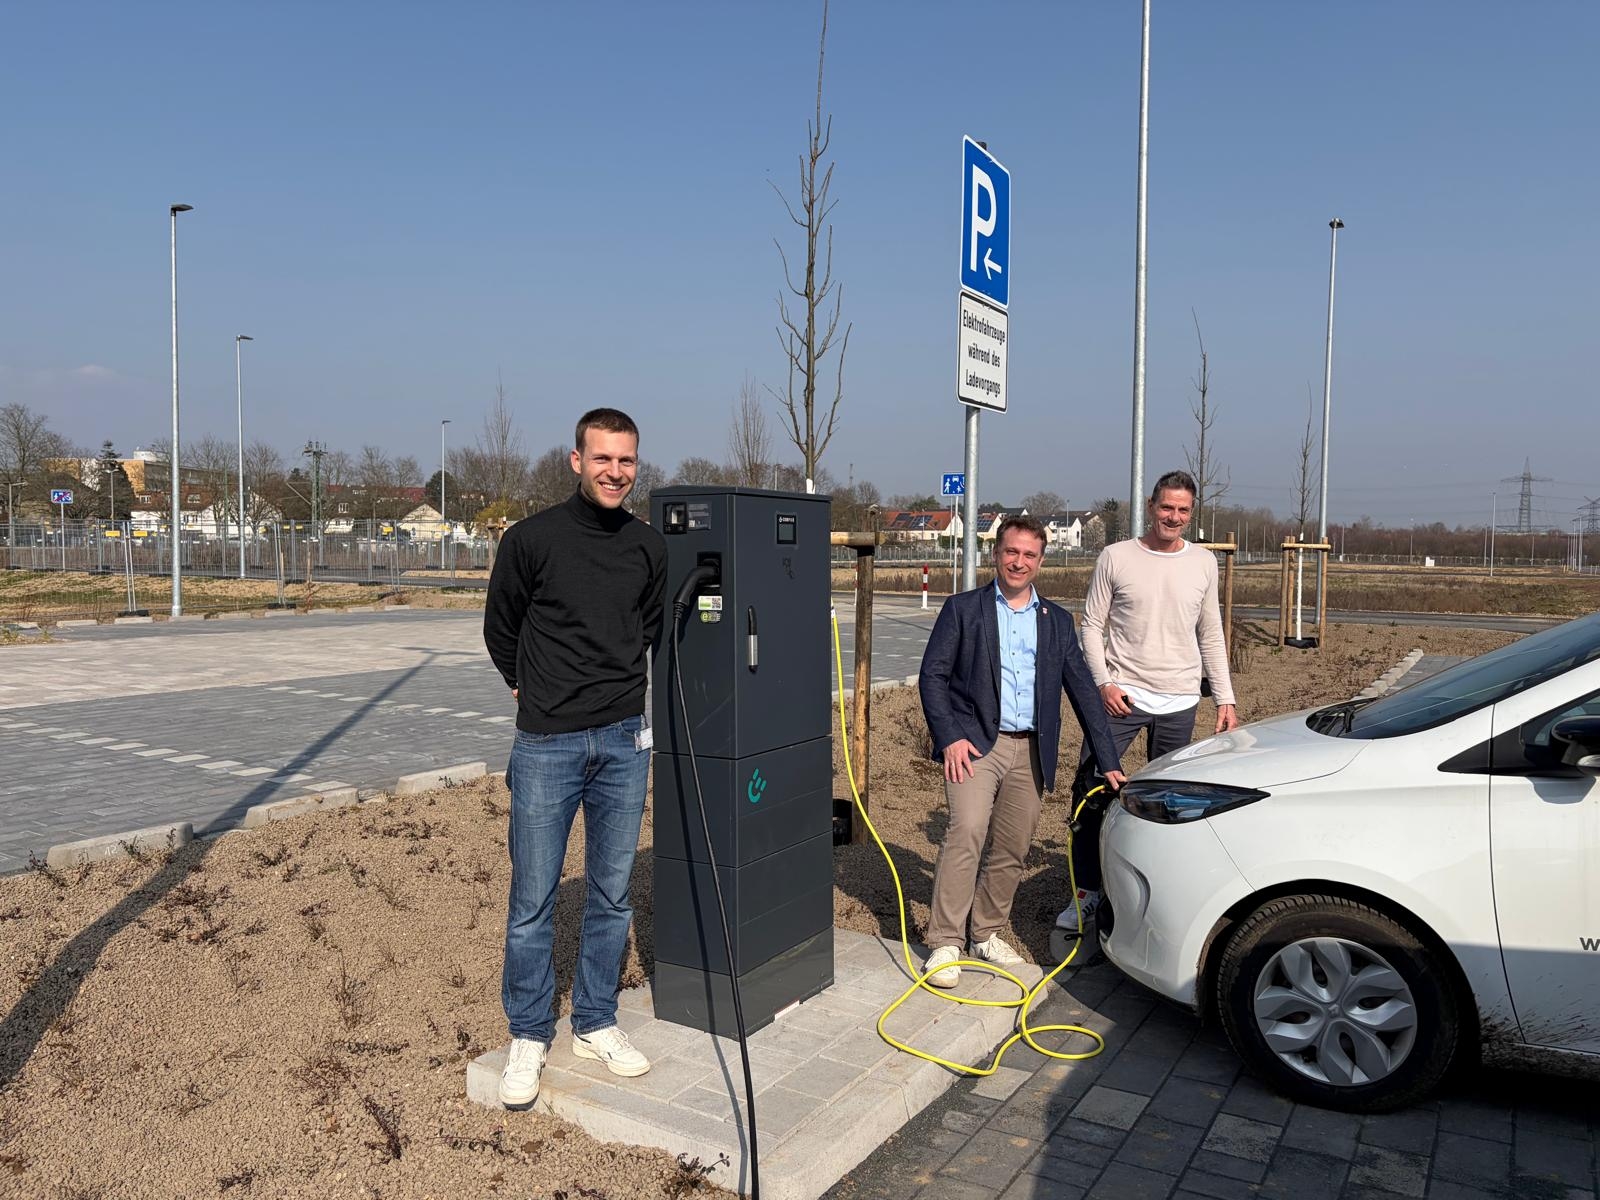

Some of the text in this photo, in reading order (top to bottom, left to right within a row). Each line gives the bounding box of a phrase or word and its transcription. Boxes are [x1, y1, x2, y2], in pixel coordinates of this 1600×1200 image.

[970, 163, 997, 273] P
[963, 309, 1006, 346] Elektrofahrzeuge
[967, 342, 1001, 368] während des
[965, 368, 1001, 398] Ladevorgangs
